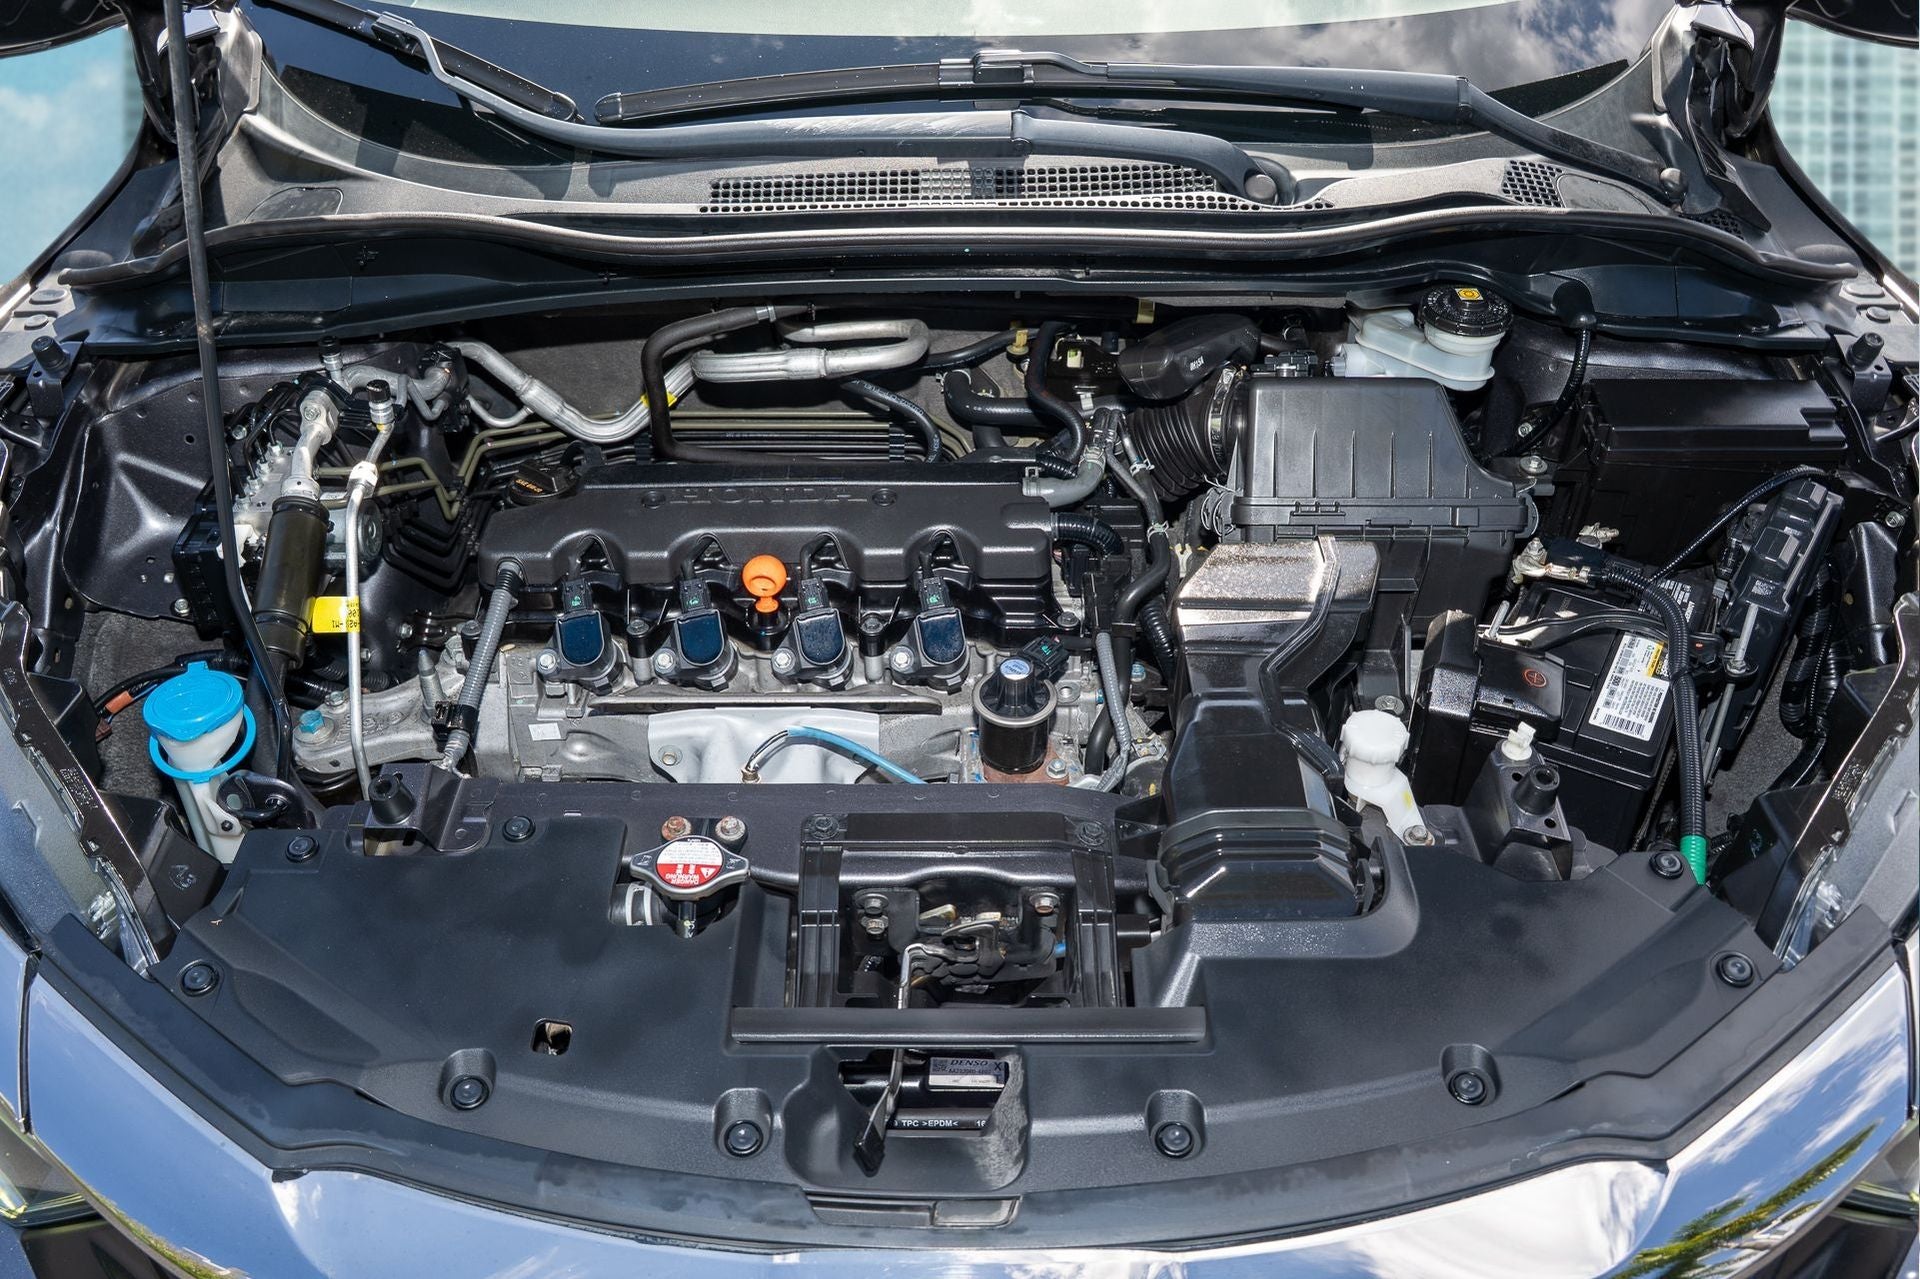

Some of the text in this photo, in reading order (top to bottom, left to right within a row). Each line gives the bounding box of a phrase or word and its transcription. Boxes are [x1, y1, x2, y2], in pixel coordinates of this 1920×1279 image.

[669, 487, 868, 504] HONDA
[665, 873, 700, 881] WARNING
[901, 1119, 919, 1127] TPC
[922, 1119, 959, 1127] >EPDM<
